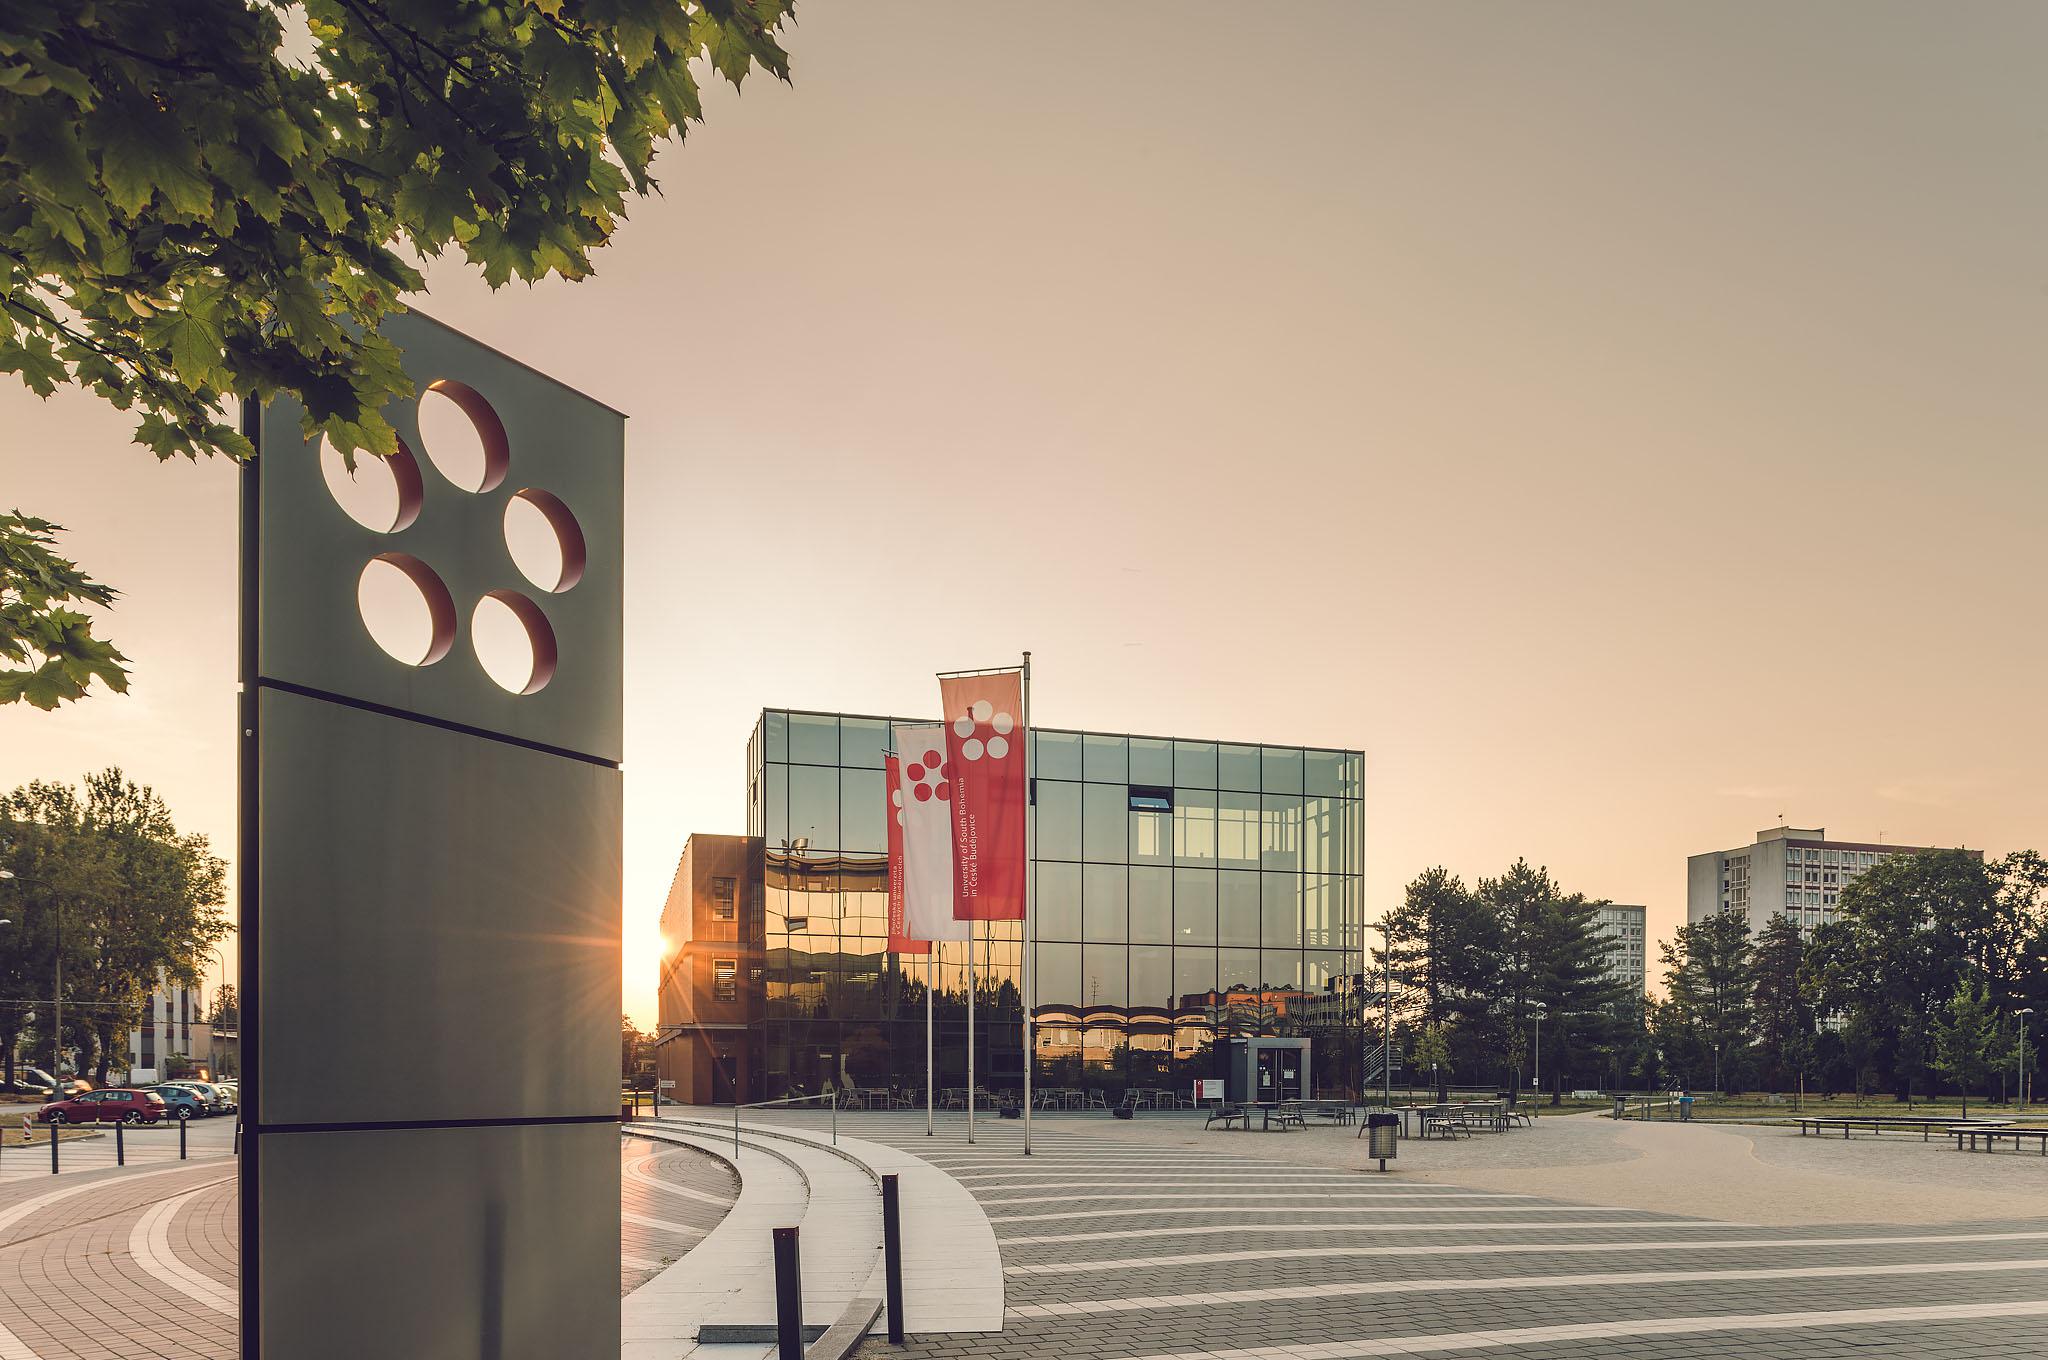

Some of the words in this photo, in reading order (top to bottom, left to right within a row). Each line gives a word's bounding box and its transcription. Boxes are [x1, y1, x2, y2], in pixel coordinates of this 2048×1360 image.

[959, 817, 968, 842] South
[968, 814, 978, 860] Budějovice
[960, 844, 967, 854] of
[969, 862, 978, 887] České
[970, 889, 978, 897] in
